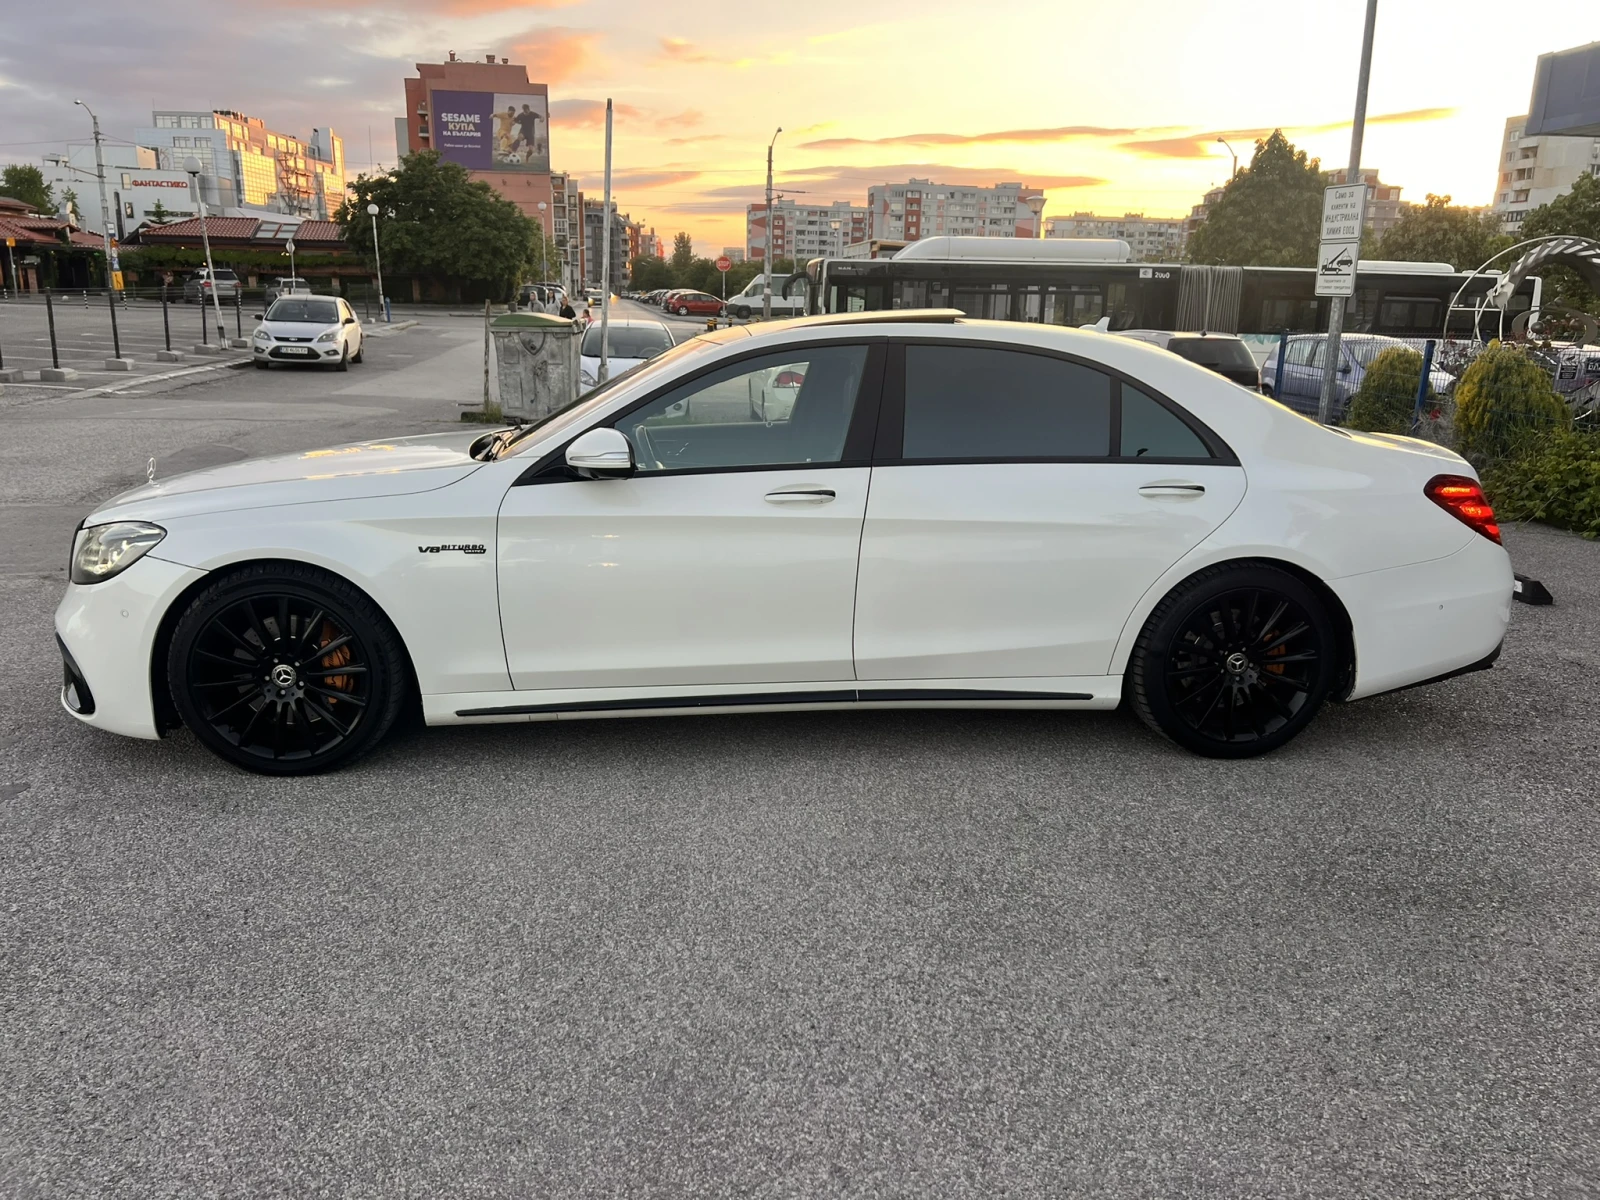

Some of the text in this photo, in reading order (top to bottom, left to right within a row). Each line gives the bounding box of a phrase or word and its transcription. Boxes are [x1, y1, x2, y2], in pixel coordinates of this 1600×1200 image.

[441, 112, 480, 123] SESAME
[448, 122, 475, 131] КУПА
[132, 180, 188, 188] ФАНТАСТИКО
